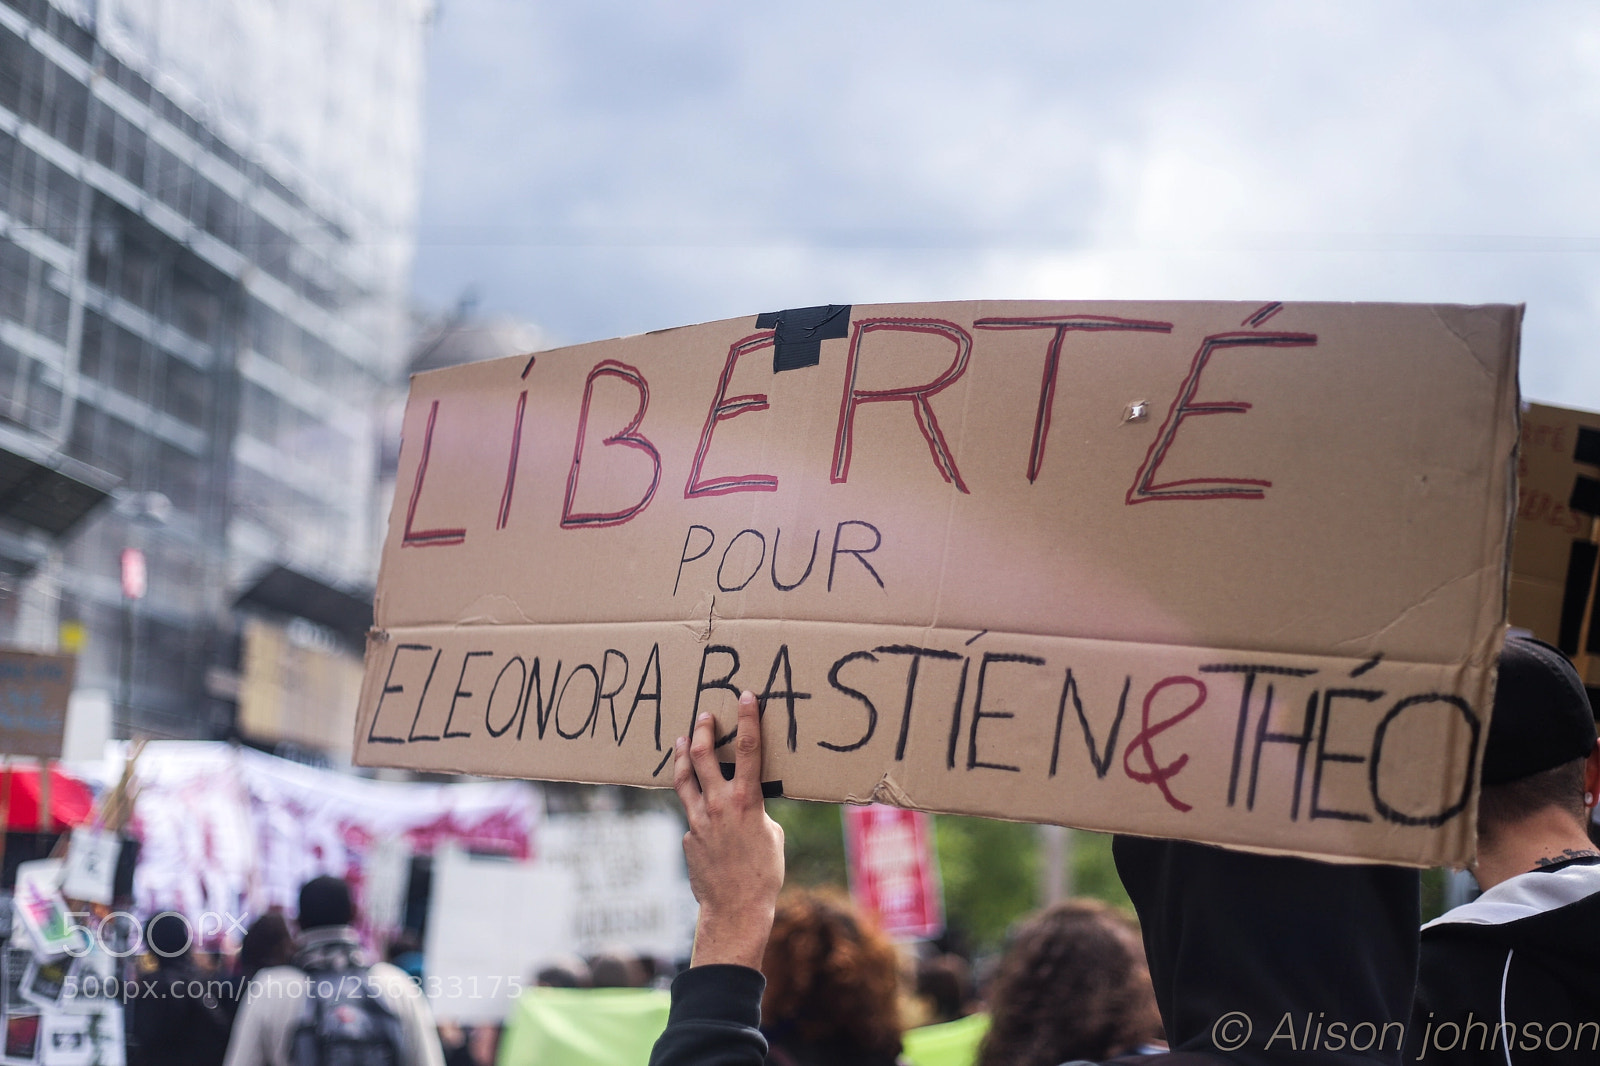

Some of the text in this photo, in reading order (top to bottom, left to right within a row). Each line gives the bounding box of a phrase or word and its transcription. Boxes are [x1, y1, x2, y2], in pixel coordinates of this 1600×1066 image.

[674, 519, 885, 597] POUR
[1123, 675, 1207, 813] &
[1199, 652, 1482, 828] THÉO
